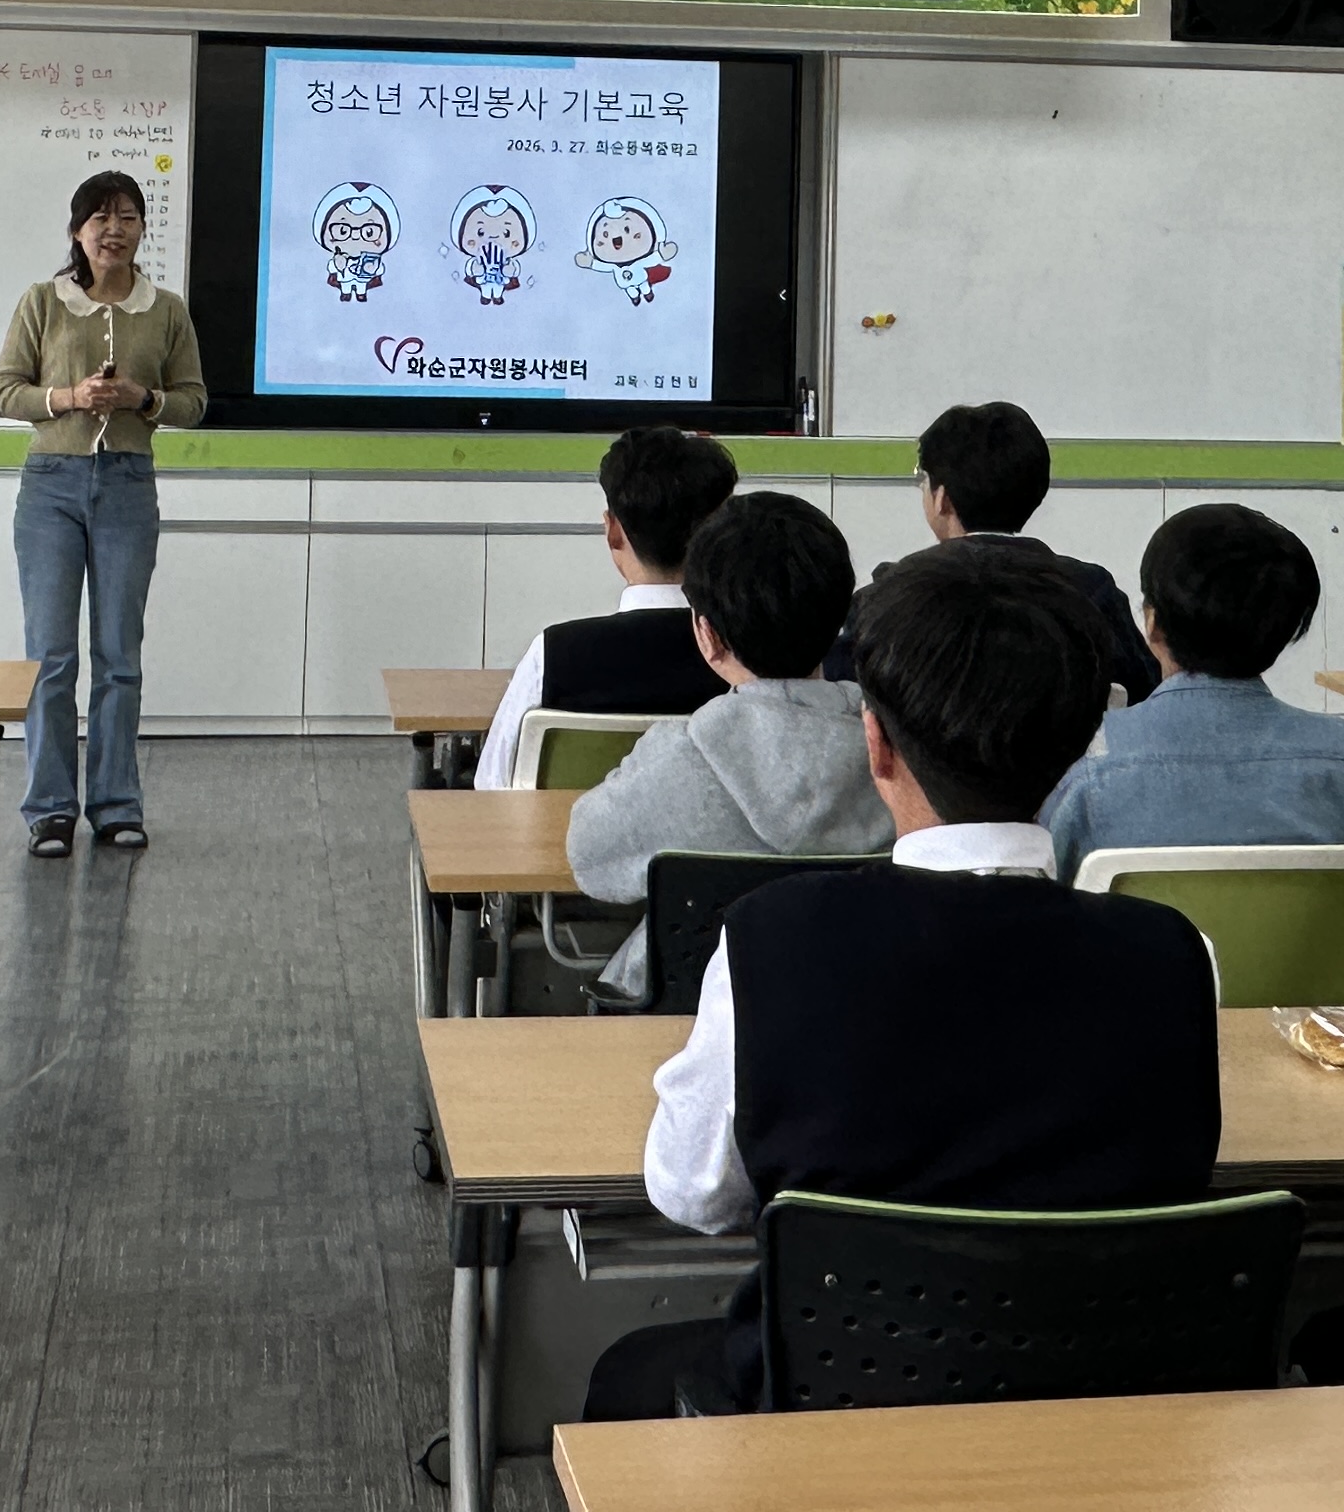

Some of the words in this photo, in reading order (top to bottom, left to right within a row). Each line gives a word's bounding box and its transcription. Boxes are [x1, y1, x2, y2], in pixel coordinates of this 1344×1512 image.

[307, 80, 402, 116] 청소년
[418, 83, 549, 122] 자원봉사
[561, 88, 689, 126] 기본교육
[406, 356, 588, 381] 화순군자원봉사센터
